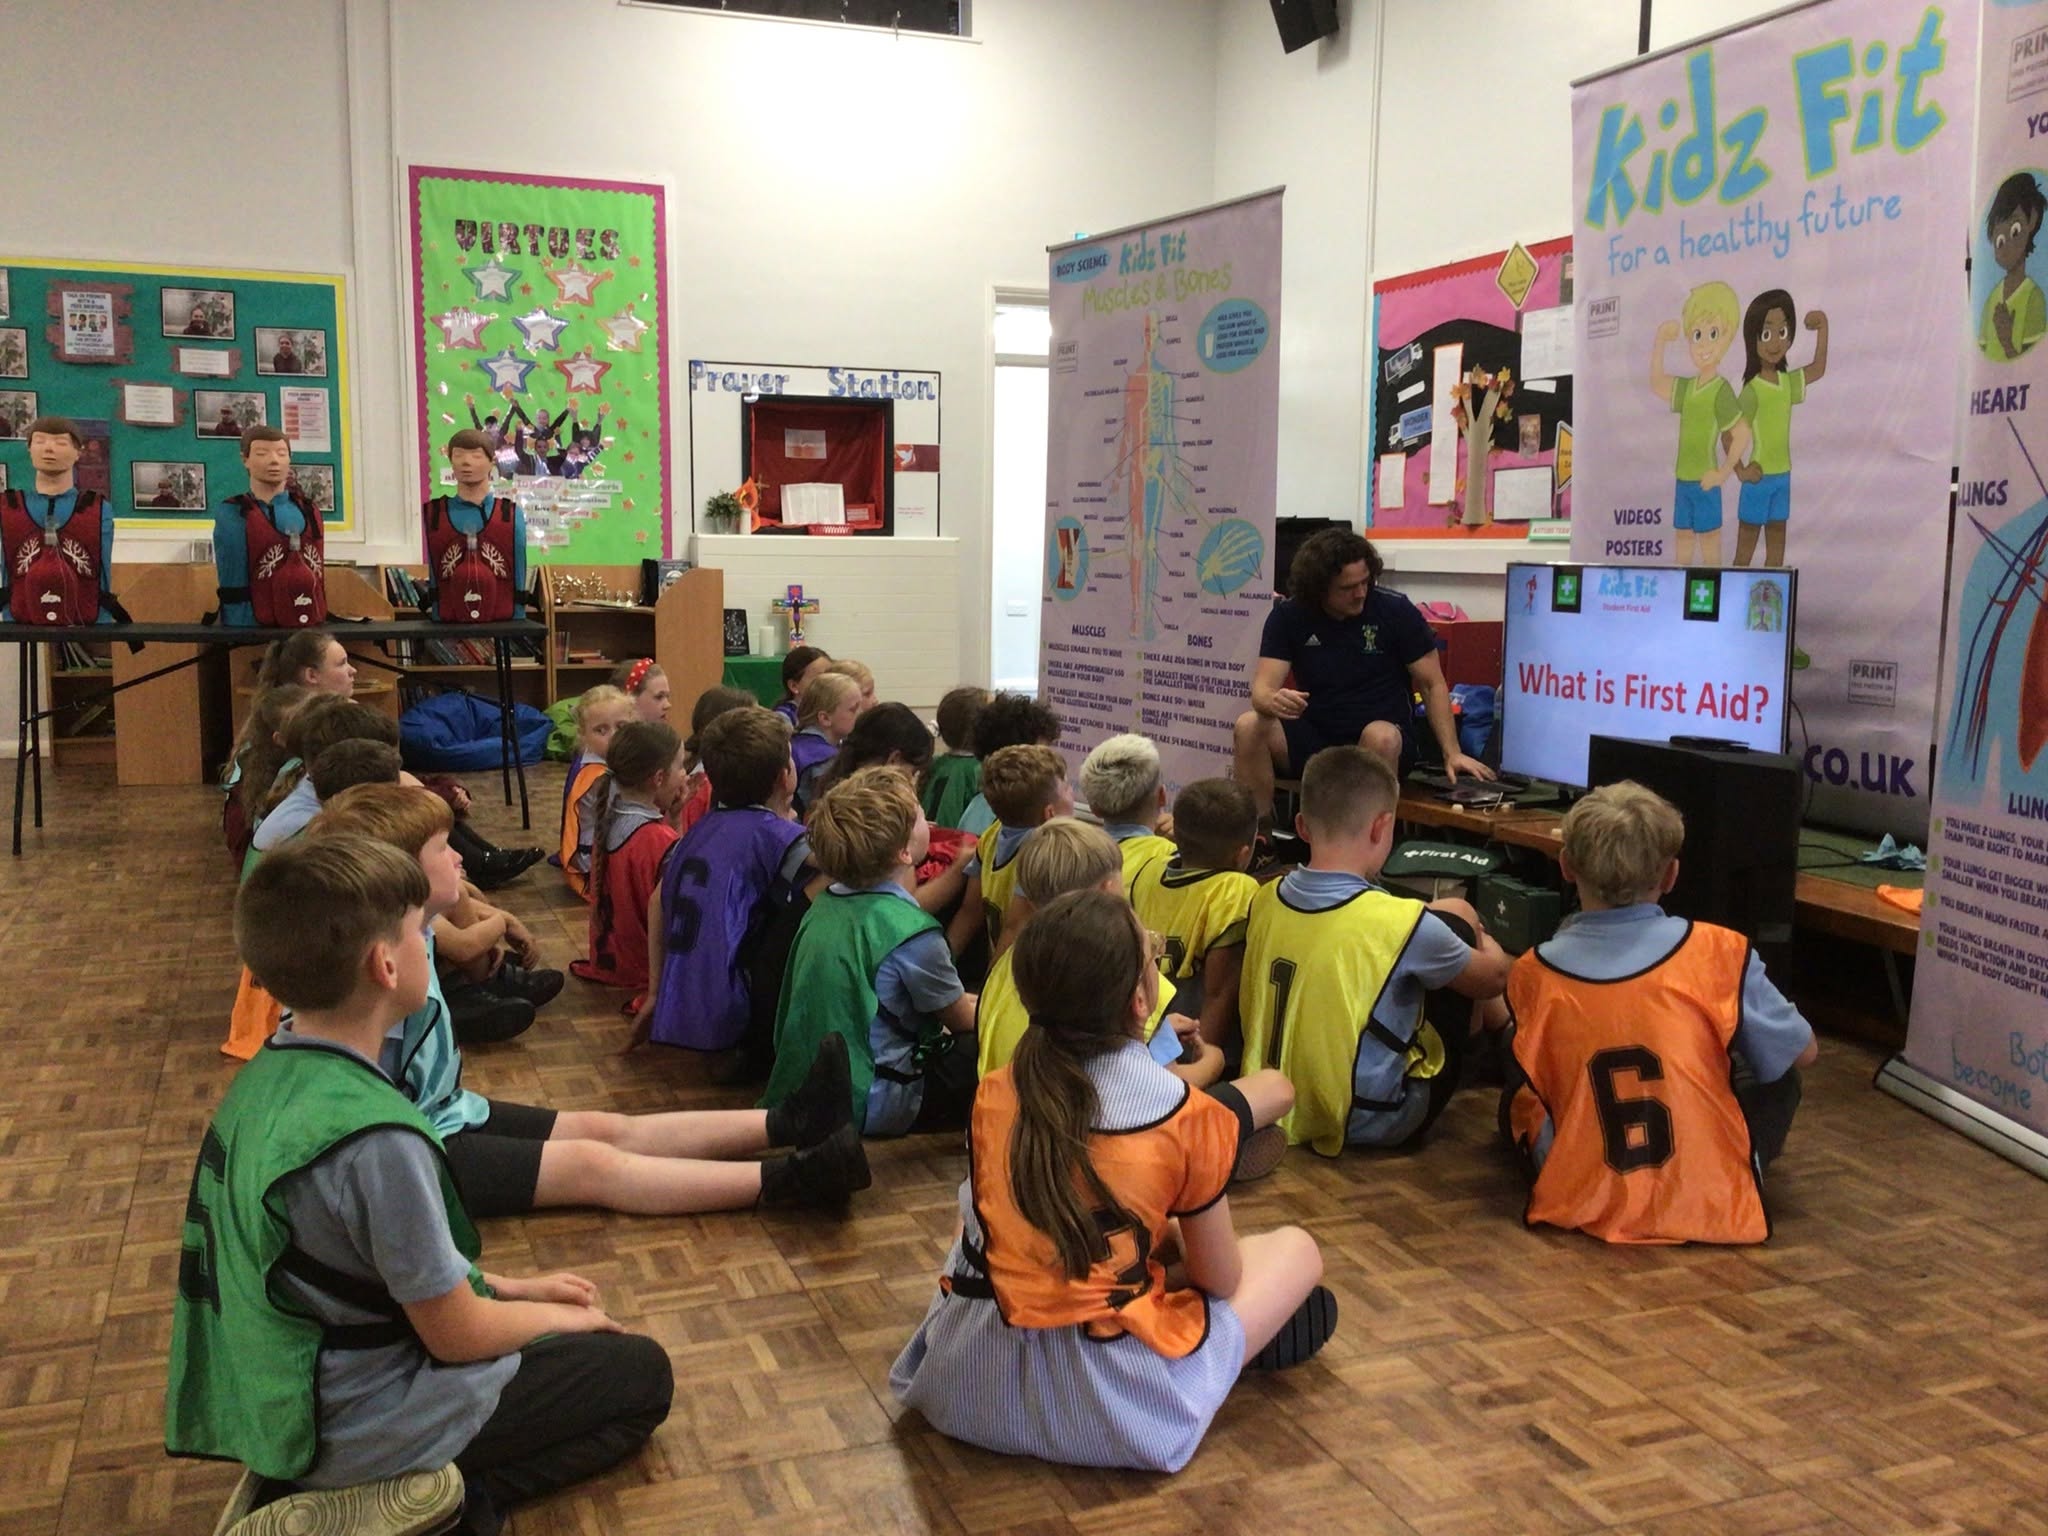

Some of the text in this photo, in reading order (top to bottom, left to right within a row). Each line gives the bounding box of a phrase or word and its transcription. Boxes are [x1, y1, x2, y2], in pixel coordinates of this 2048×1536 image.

[1585, 5, 1948, 231] Kidz Fit
[1654, 245, 1670, 266] a
[1679, 201, 1791, 259] healthy
[1796, 184, 1903, 237] future
[455, 219, 622, 261] VIRTUES
[1160, 229, 1187, 267] Fit
[1056, 253, 1108, 278] BODY SCIENCE
[1174, 261, 1233, 302] Bones
[690, 360, 936, 403] Prayer Station
[1970, 384, 2030, 415] HEART
[1614, 508, 1662, 525] VIDEOS
[1606, 540, 1663, 556] POSTERS
[1635, 574, 1659, 598] Fit
[1072, 624, 1106, 638] MUSCLES
[1187, 634, 1213, 648] BONES
[1211, 660, 1226, 670] YOUR
[1228, 662, 1245, 672] BODY
[1853, 663, 1893, 680] PRINT
[1519, 662, 1769, 724] What is First Aid?
[1965, 835, 1985, 850] YOUR
[1987, 841, 2010, 856] RIGHT
[2013, 847, 2023, 859] TO
[1982, 826, 1988, 836] 2
[2021, 835, 2044, 851] YOUR
[1419, 850, 1489, 866] First Aid
[1976, 880, 1999, 895] WHEN
[2001, 887, 2018, 901] YOU
[2004, 873, 2033, 891] BIGGER
[666, 857, 711, 954] 6
[2009, 918, 2040, 937] FASTER
[2009, 960, 2027, 976] AND
[1267, 957, 1297, 1069] 1
[1952, 1038, 2032, 1110] become
[1587, 1045, 1675, 1176] 6
